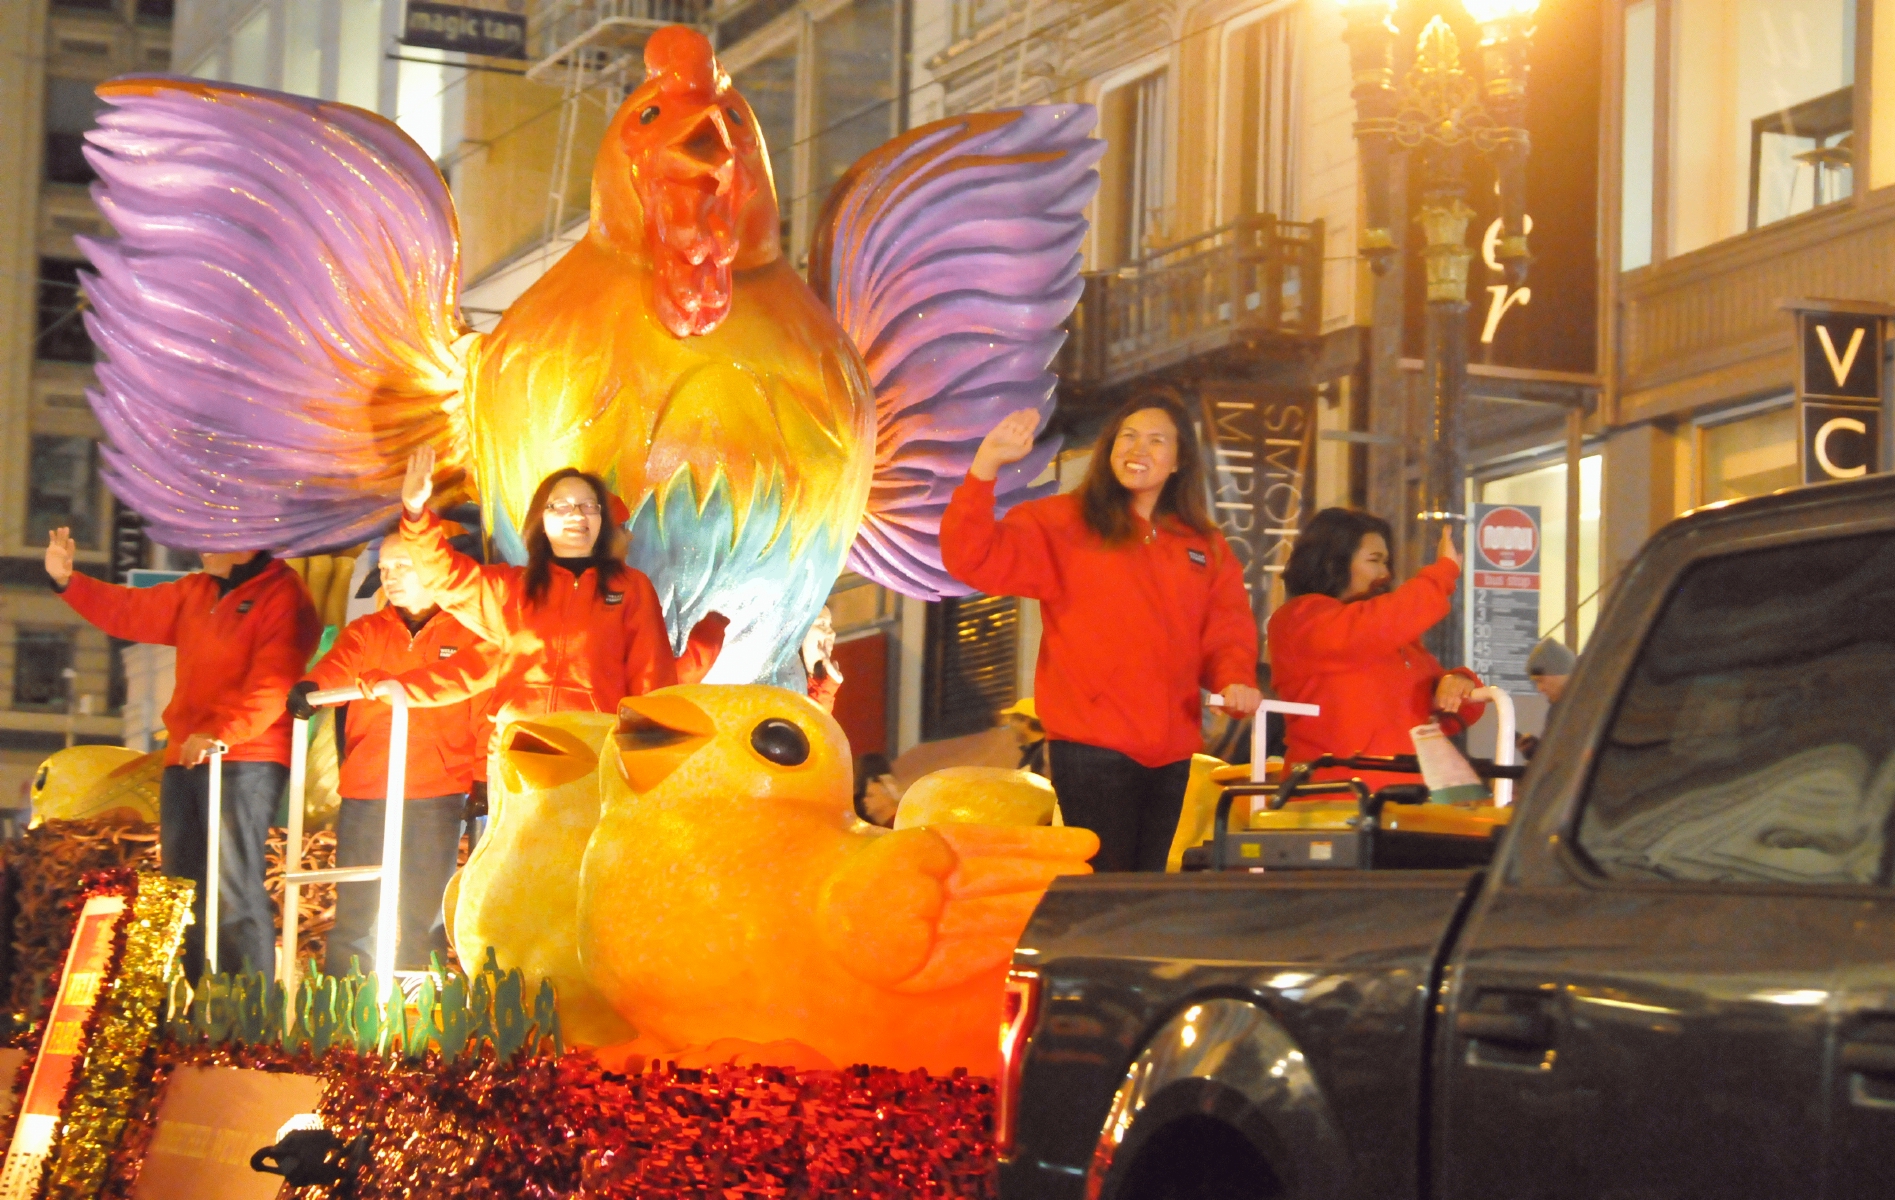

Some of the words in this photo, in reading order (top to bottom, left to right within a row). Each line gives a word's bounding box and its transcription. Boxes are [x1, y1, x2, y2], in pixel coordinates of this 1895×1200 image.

[408, 11, 477, 40] magic
[483, 18, 521, 42] tan
[1215, 401, 1255, 609] MIRRO
